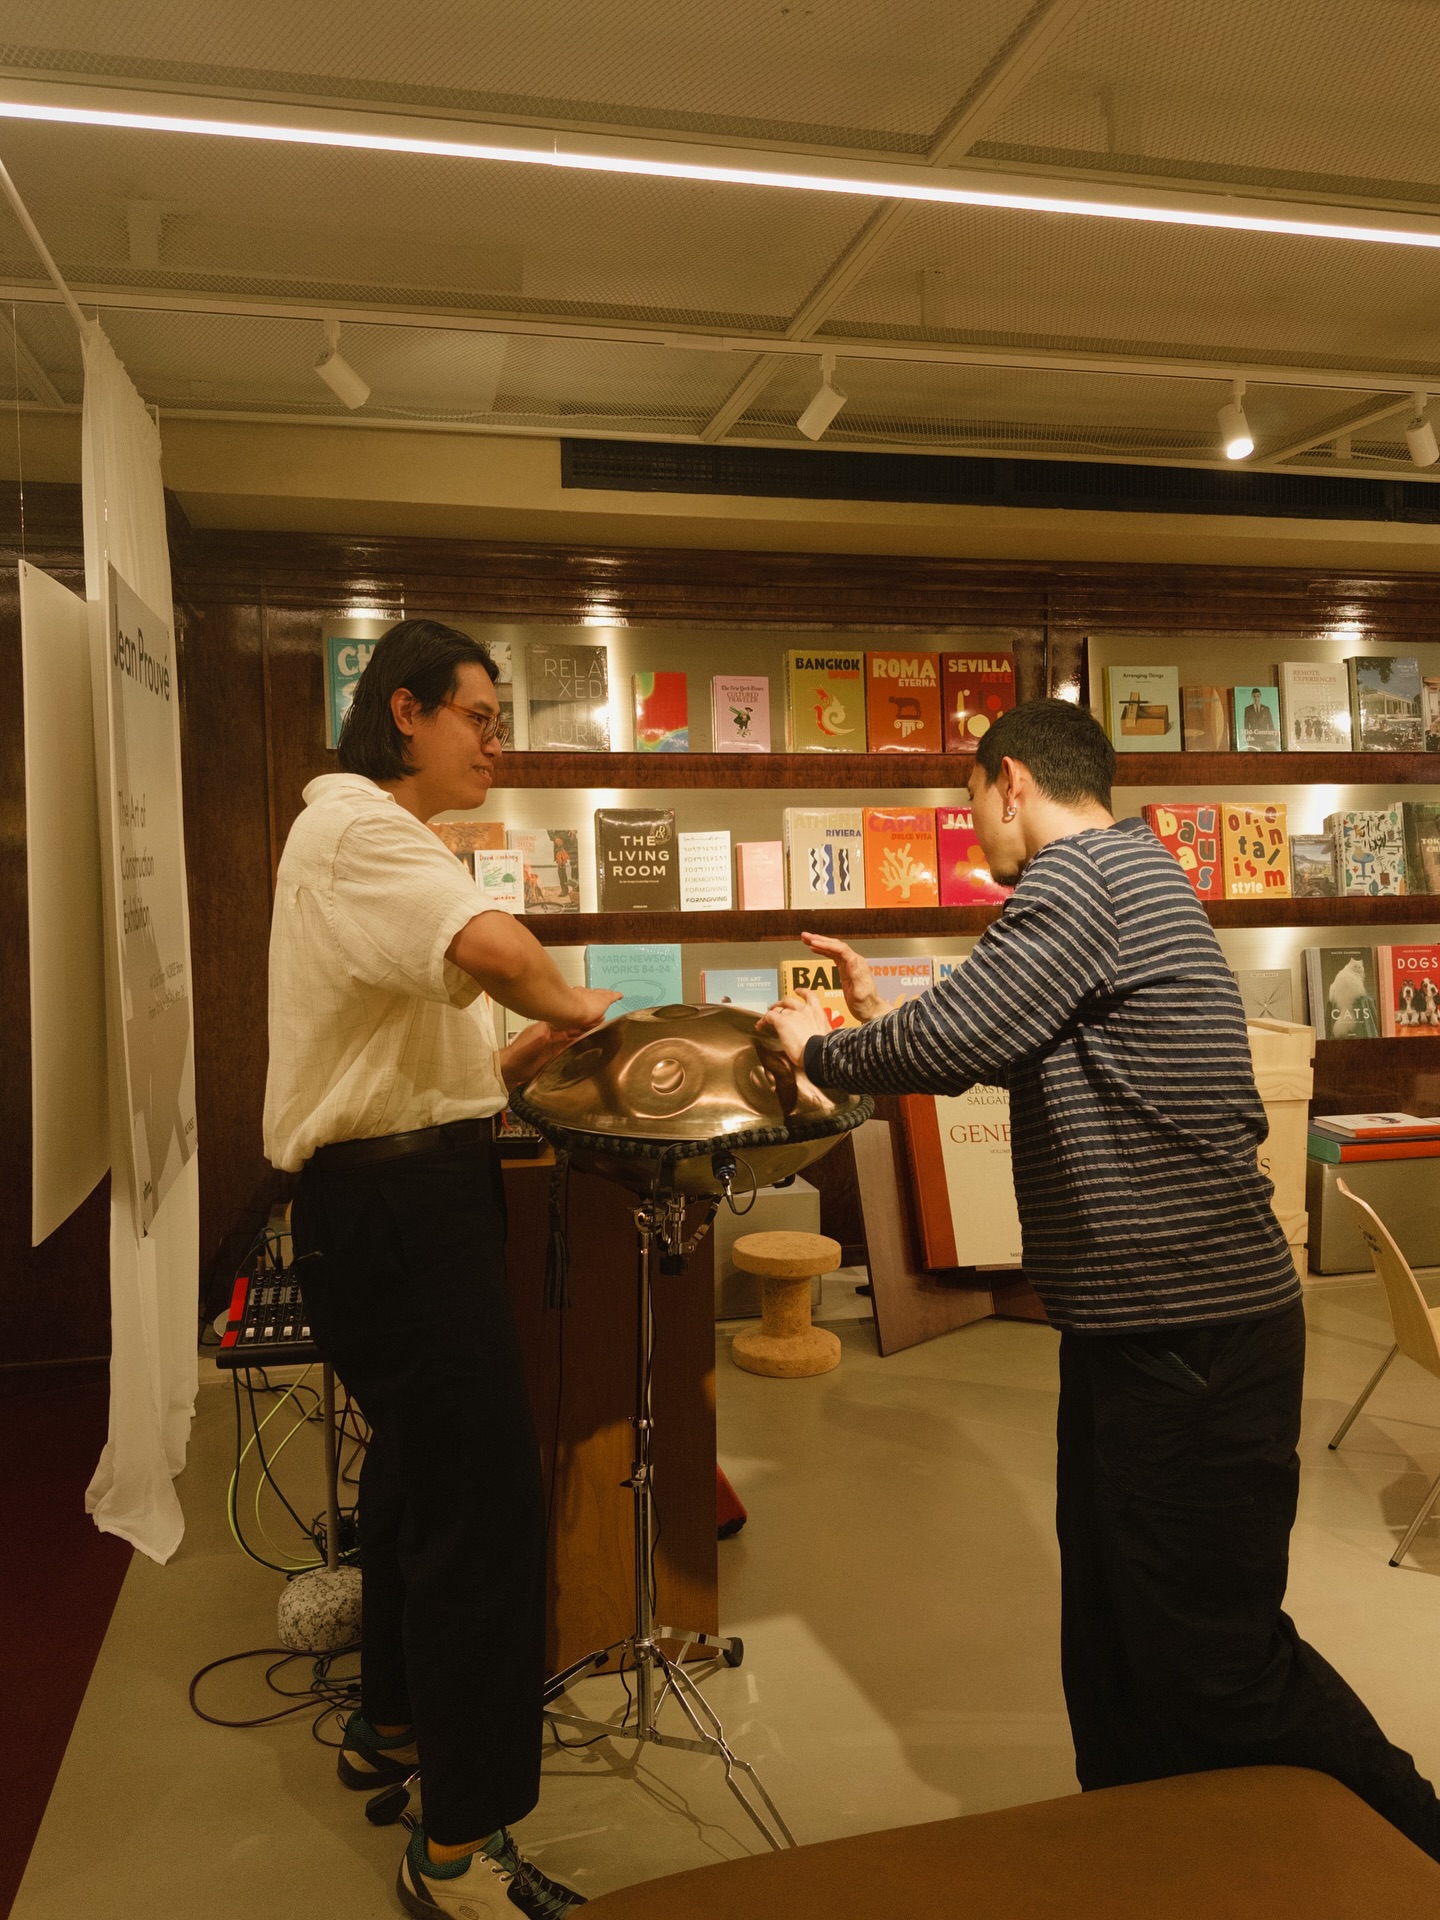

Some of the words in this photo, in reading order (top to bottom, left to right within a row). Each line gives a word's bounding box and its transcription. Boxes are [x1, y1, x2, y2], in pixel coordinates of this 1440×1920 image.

[113, 604, 137, 681] Jean
[138, 627, 170, 702] Prouvé
[544, 658, 602, 678] RELA
[795, 658, 860, 671] BANGKOK
[873, 658, 936, 679] ROMA
[948, 659, 1012, 673] SEVILLA
[898, 679, 936, 687] ETERNA
[981, 673, 1012, 683] ARTE
[558, 680, 602, 698] XED
[558, 703, 600, 722] LU
[869, 814, 932, 832] CAPRI
[825, 829, 862, 837] RIVIERA
[620, 835, 656, 846] THE
[608, 850, 670, 861] LIVING
[613, 865, 666, 877] ROOM
[1231, 881, 1263, 895] style
[597, 954, 627, 963] MARC
[629, 954, 675, 963] NEWSON
[1397, 957, 1439, 969] DOGS
[602, 965, 640, 974] WORKS
[641, 965, 671, 974] 84-24
[900, 977, 930, 986] GLORY
[1331, 1008, 1370, 1020] CATS
[950, 1124, 1011, 1143] GENE
